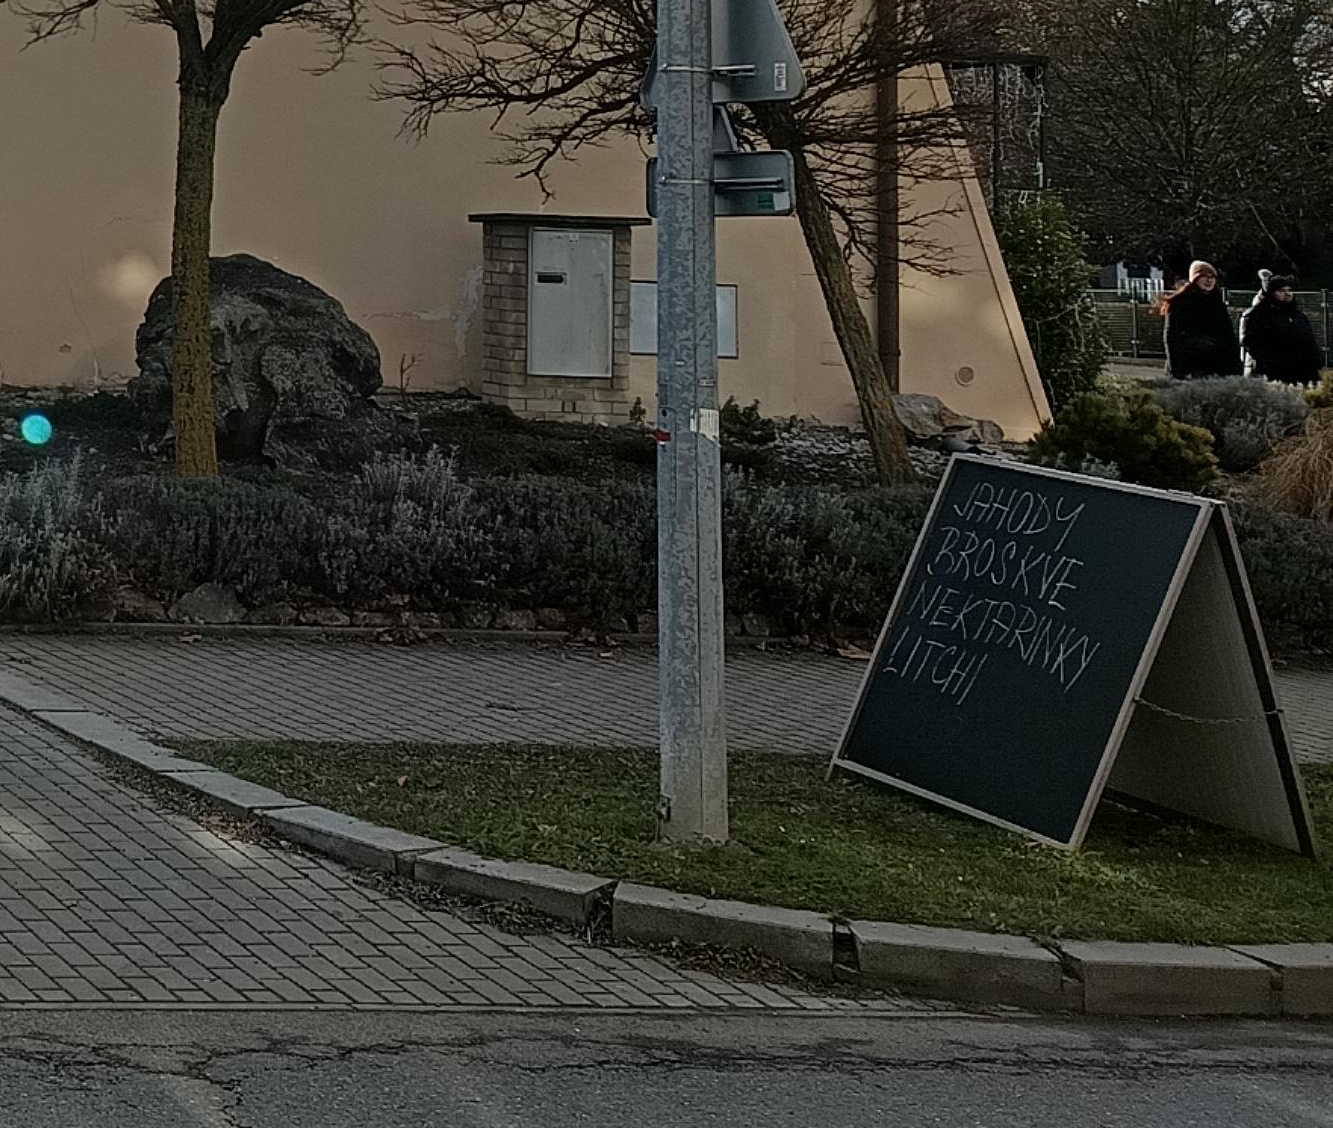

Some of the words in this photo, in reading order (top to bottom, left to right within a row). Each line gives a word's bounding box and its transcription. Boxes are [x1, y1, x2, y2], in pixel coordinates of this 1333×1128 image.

[953, 481, 1085, 552] JAHODY
[927, 526, 1085, 611] BROSKVE
[882, 625, 988, 706] LITCHI
[906, 579, 1101, 694] NEKTARINKY
